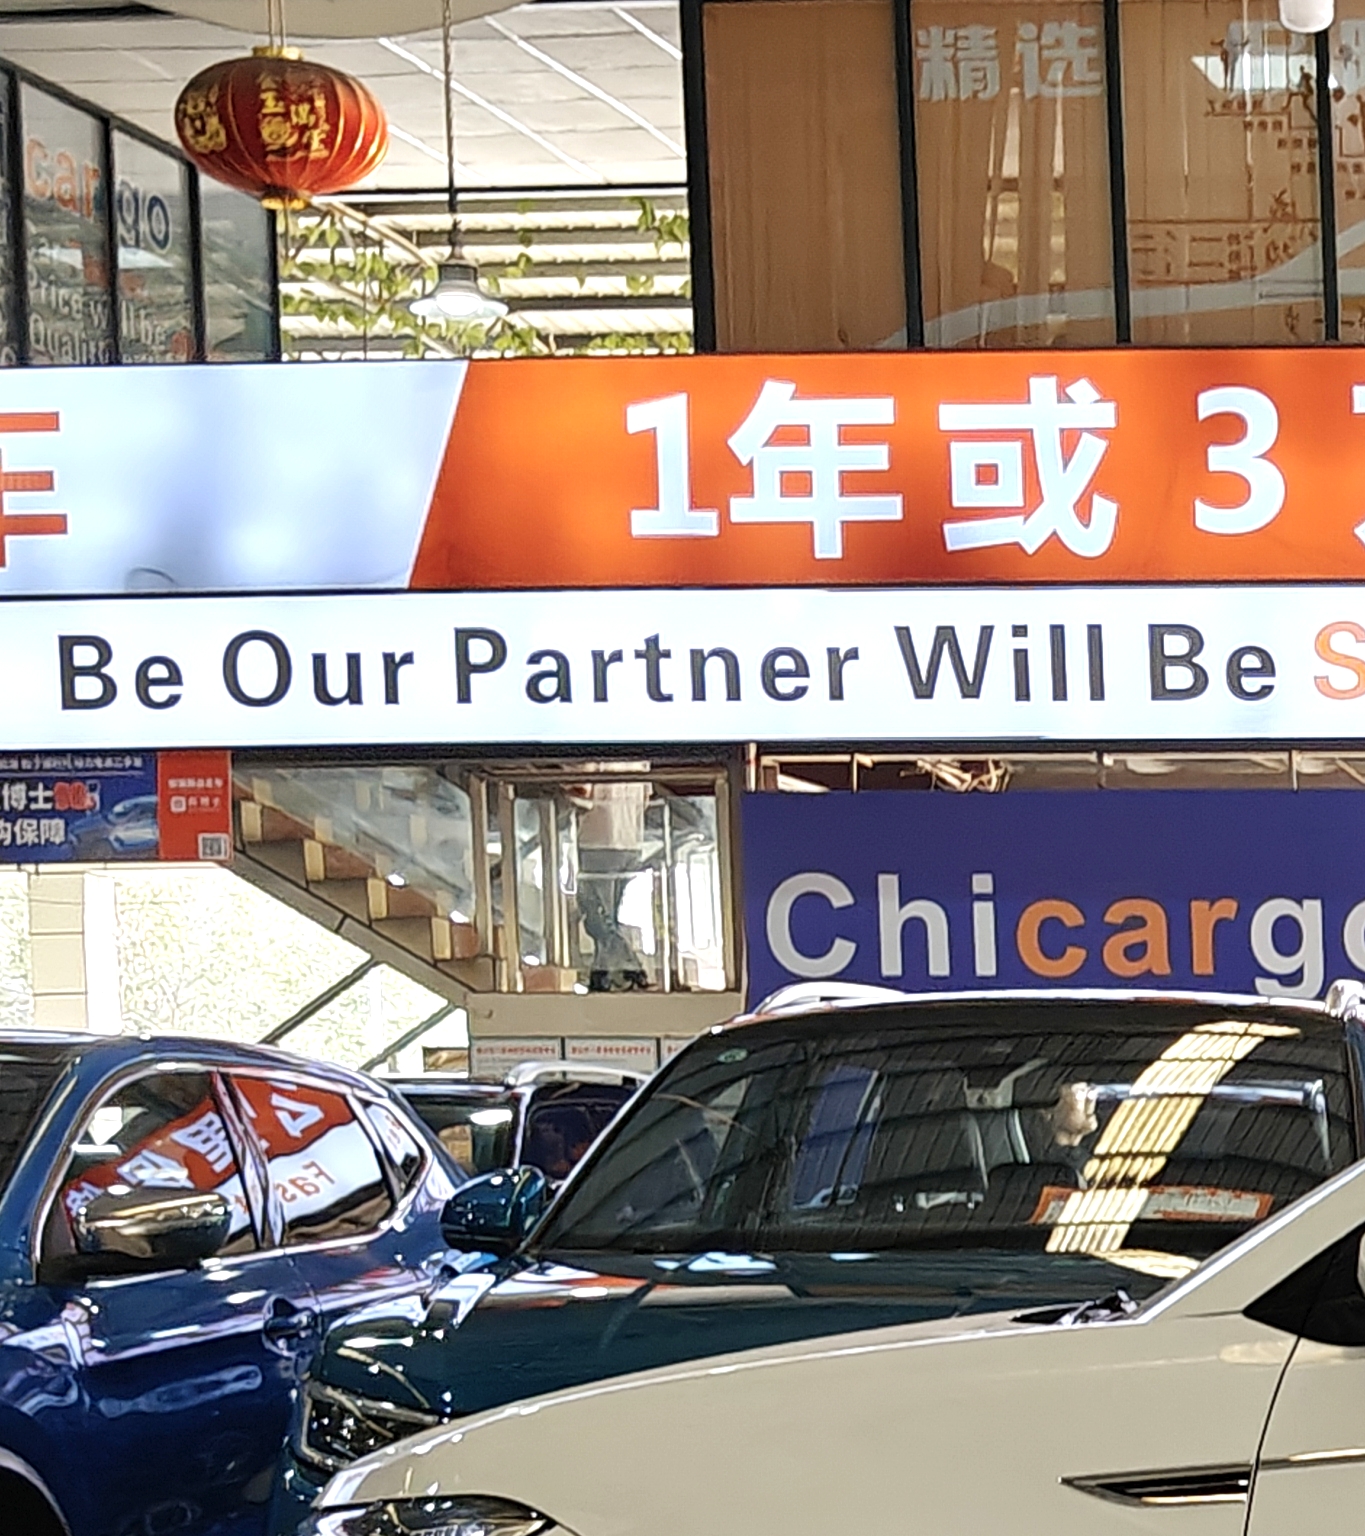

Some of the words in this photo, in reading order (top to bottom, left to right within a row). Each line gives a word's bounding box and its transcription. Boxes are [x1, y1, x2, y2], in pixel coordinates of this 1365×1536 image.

[916, 20, 1105, 102] 精选
[58, 633, 184, 712] Be
[221, 628, 417, 711] Our
[453, 624, 860, 706] Partner
[894, 621, 1106, 704] Will
[1147, 621, 1279, 703] Be
